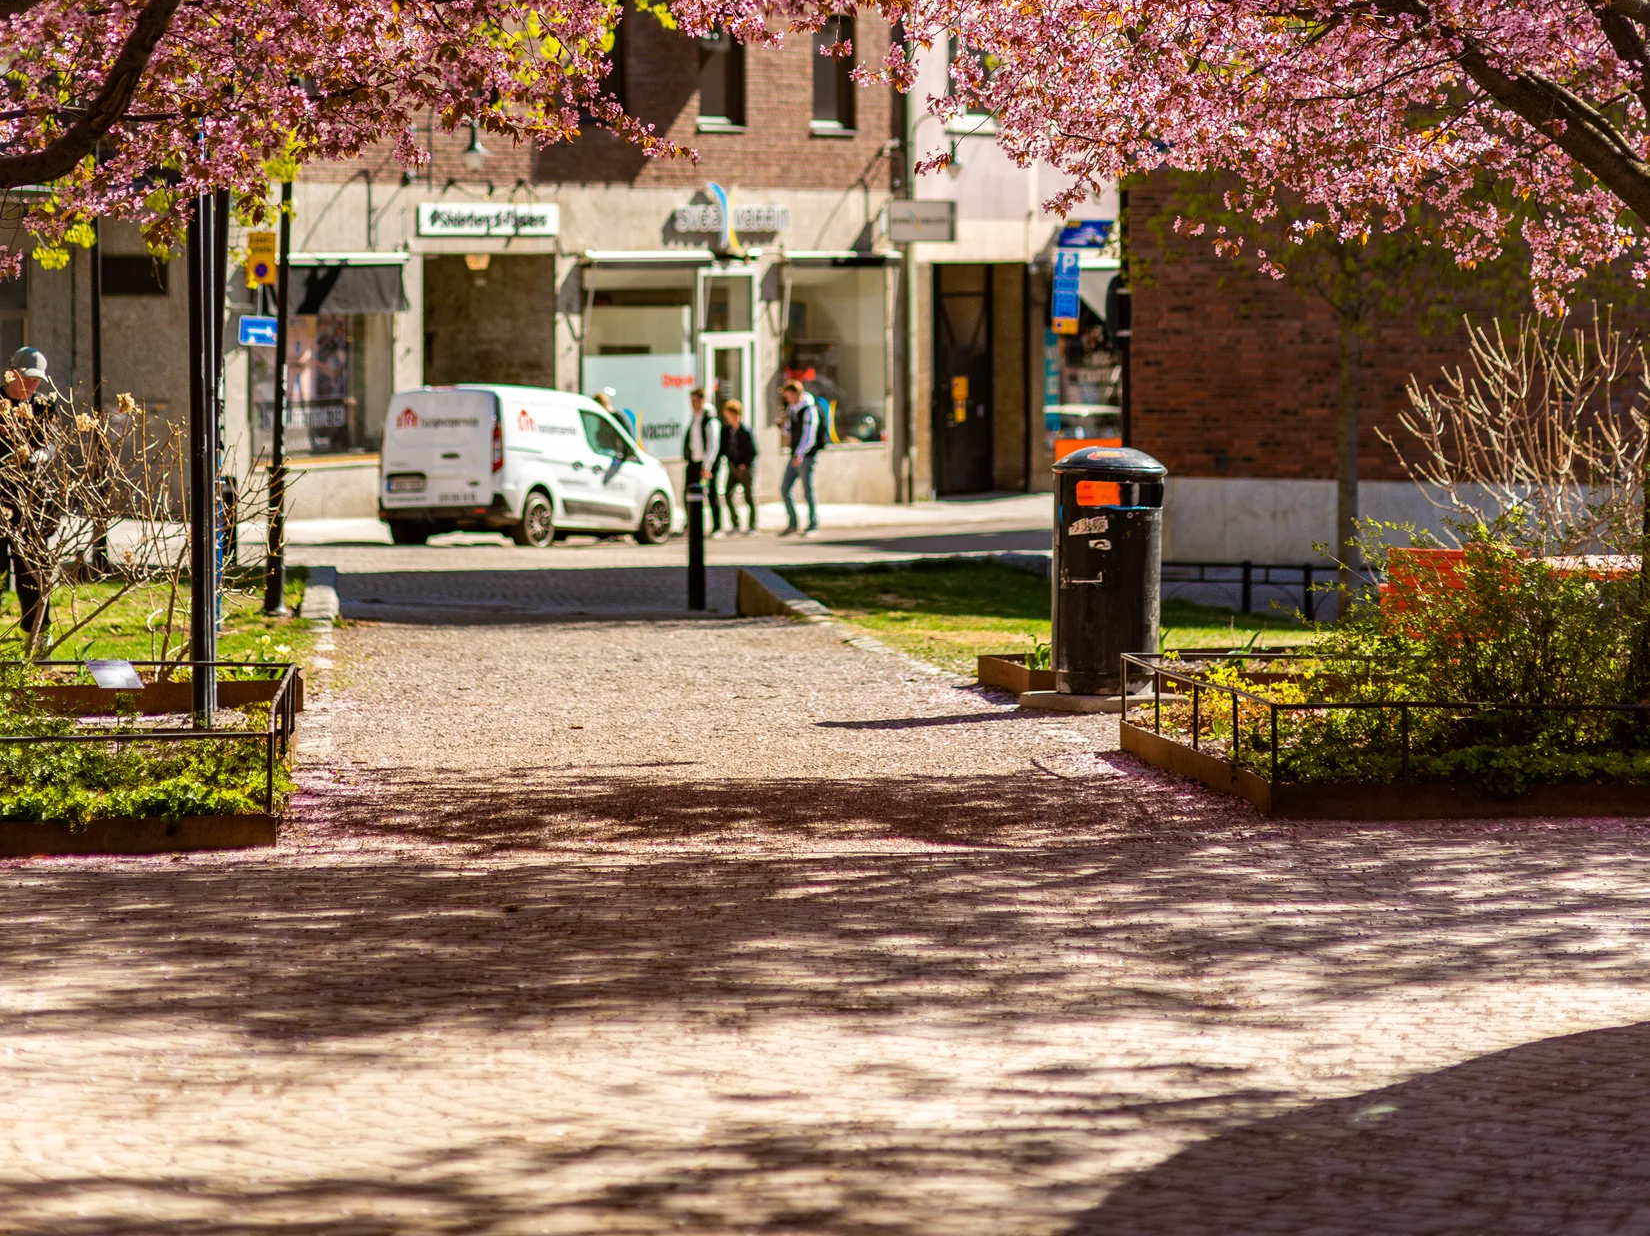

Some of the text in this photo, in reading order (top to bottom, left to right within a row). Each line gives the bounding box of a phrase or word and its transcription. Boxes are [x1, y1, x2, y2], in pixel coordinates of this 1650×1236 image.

[676, 203, 787, 231] svea vaccin
[1062, 254, 1076, 274] P
[642, 417, 679, 440] vaccin
